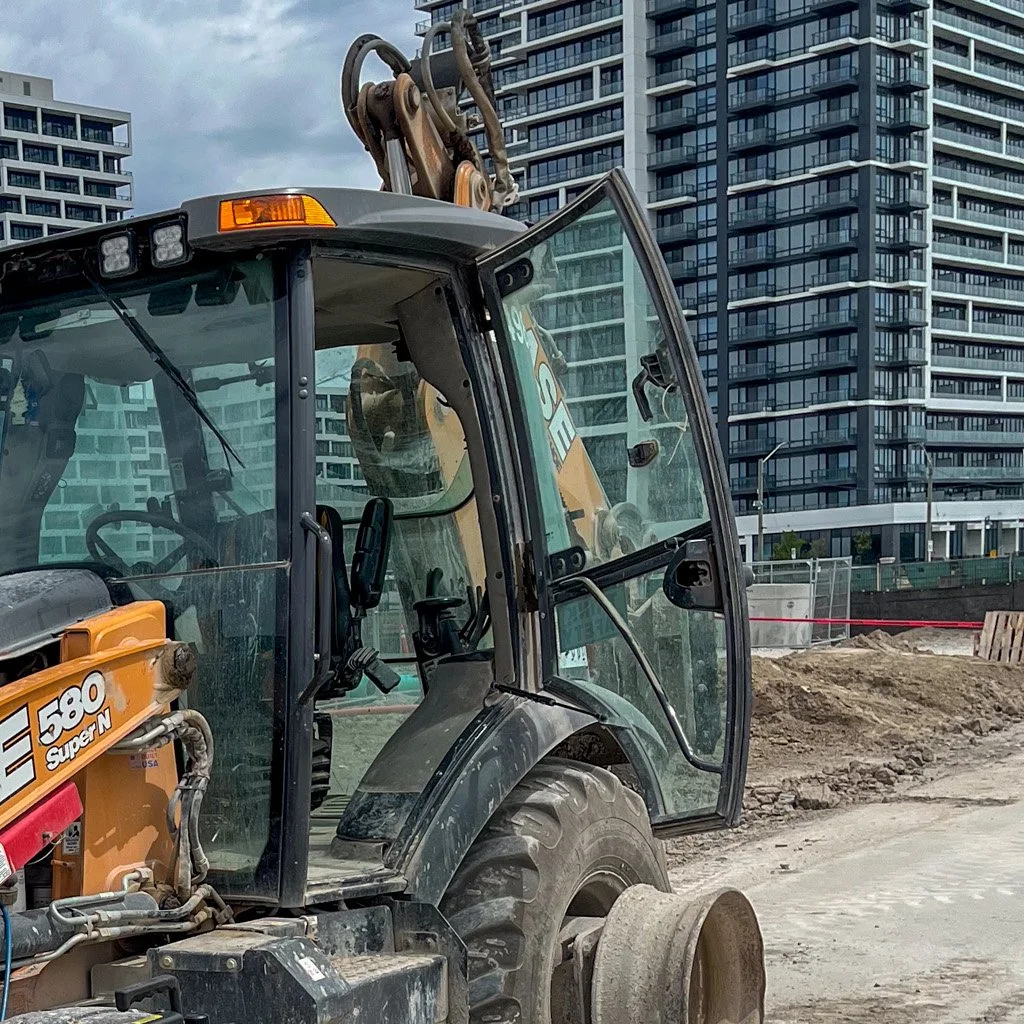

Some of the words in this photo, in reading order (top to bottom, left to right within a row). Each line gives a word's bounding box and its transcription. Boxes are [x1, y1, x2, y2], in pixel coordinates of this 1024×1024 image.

[36, 670, 106, 746] 580
[45, 721, 96, 771] Super
[97, 706, 112, 737] N
[142, 760, 159, 768] USA
